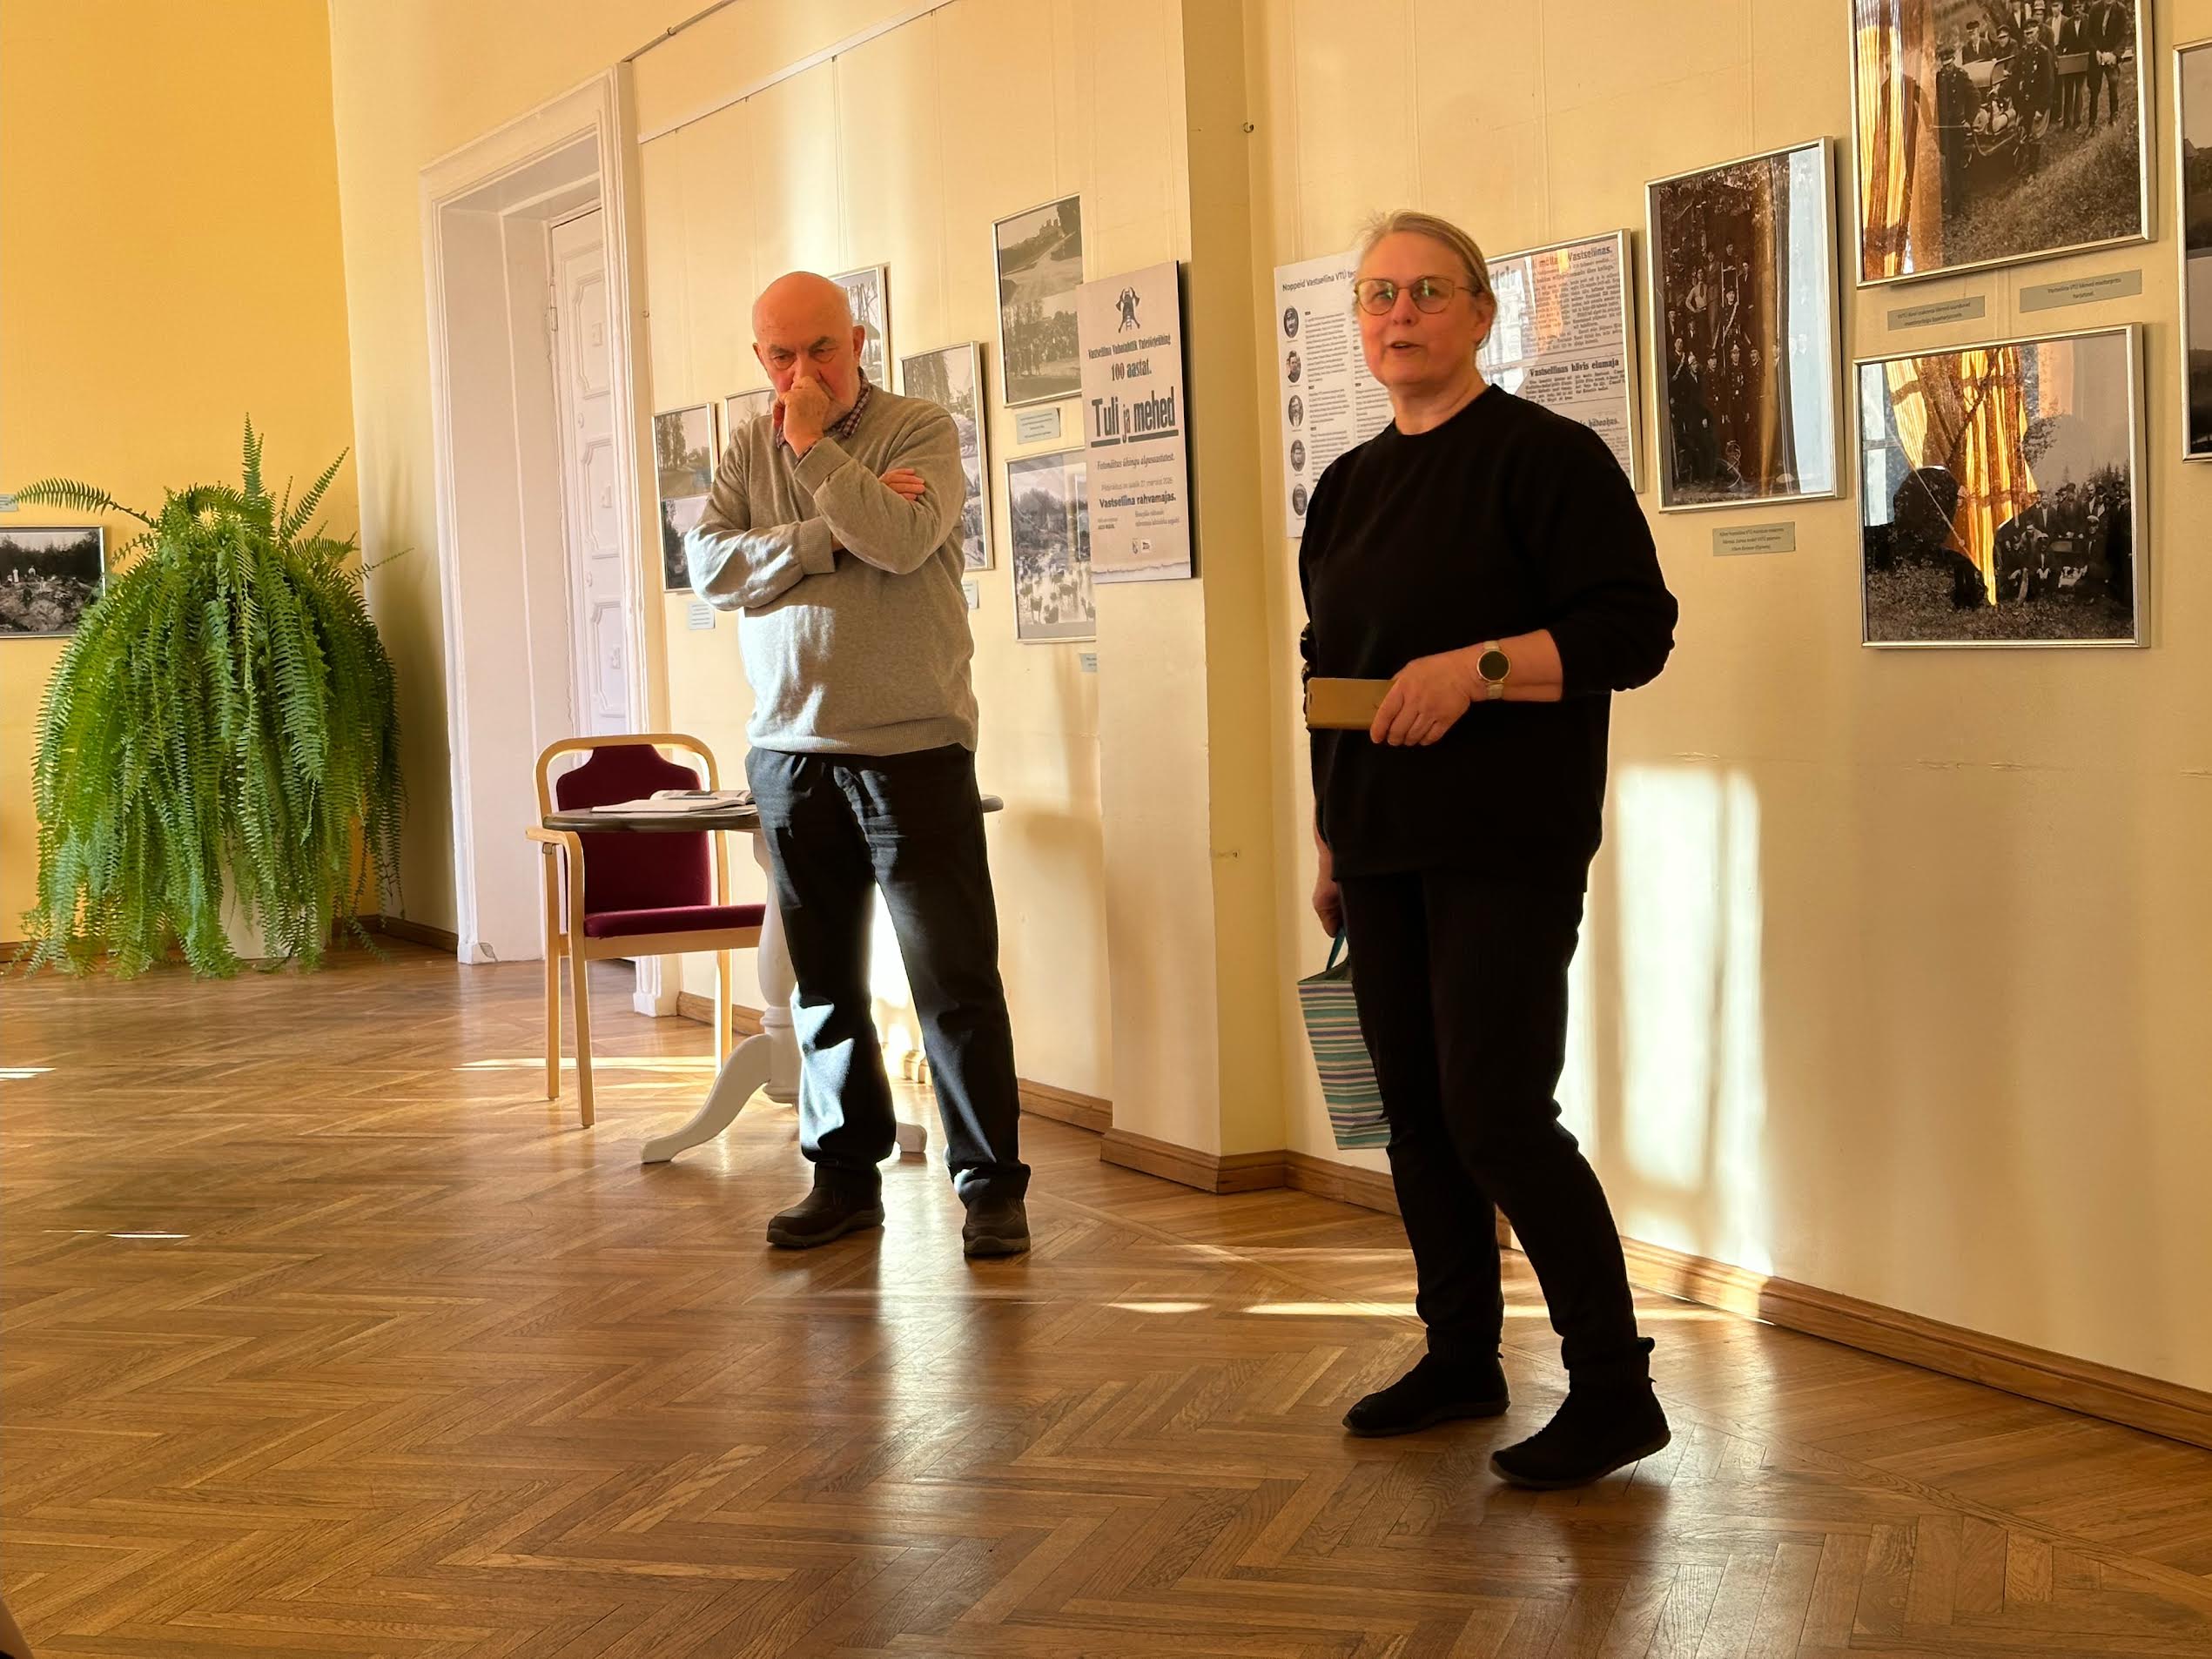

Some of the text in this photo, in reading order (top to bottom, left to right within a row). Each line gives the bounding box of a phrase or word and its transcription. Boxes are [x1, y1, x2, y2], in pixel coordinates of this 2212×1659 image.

[1568, 247, 1612, 262] Vastseliinas.
[1282, 279, 1305, 292] Noppeid
[1307, 274, 1334, 286] Vastseliina
[1335, 270, 1347, 280] VTÜ
[1087, 348, 1112, 359] Vastseliina
[1111, 357, 1152, 381] 100 aastat.
[1530, 367, 1568, 377] Vastseliinas
[1591, 358, 1619, 369] elumaja
[1092, 396, 1119, 437] Tuli
[1123, 404, 1131, 443] ja
[1133, 386, 1175, 433] mehed
[1099, 490, 1176, 508] Vastseliina rahvamajas.
